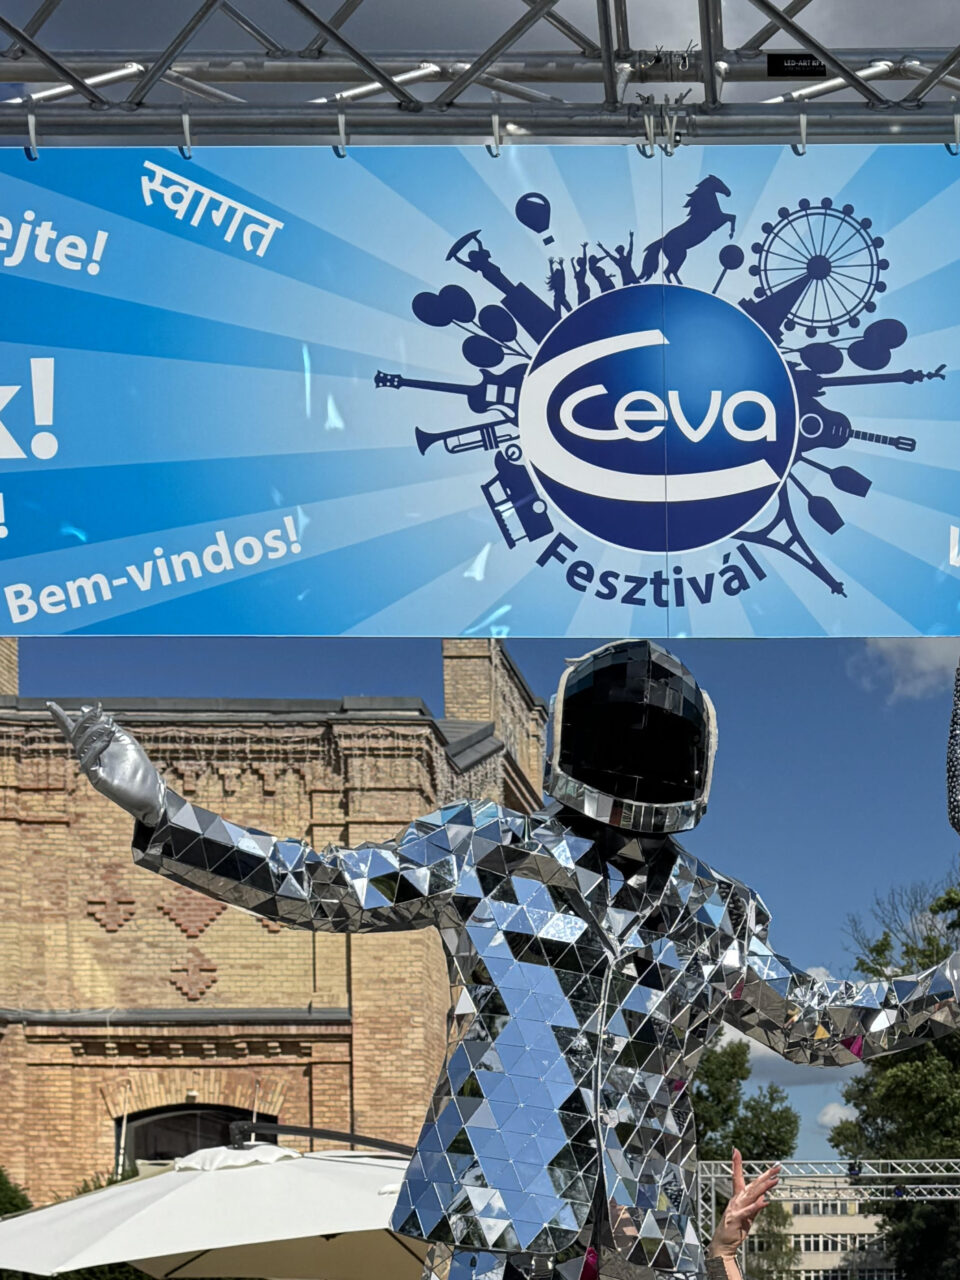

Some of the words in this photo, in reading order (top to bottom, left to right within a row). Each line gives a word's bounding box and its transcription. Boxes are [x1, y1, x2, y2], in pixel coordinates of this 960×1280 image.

[141, 160, 285, 258] स्वागत
[3, 516, 302, 624] Bem-vindos!
[535, 531, 768, 608] Fesztivál
